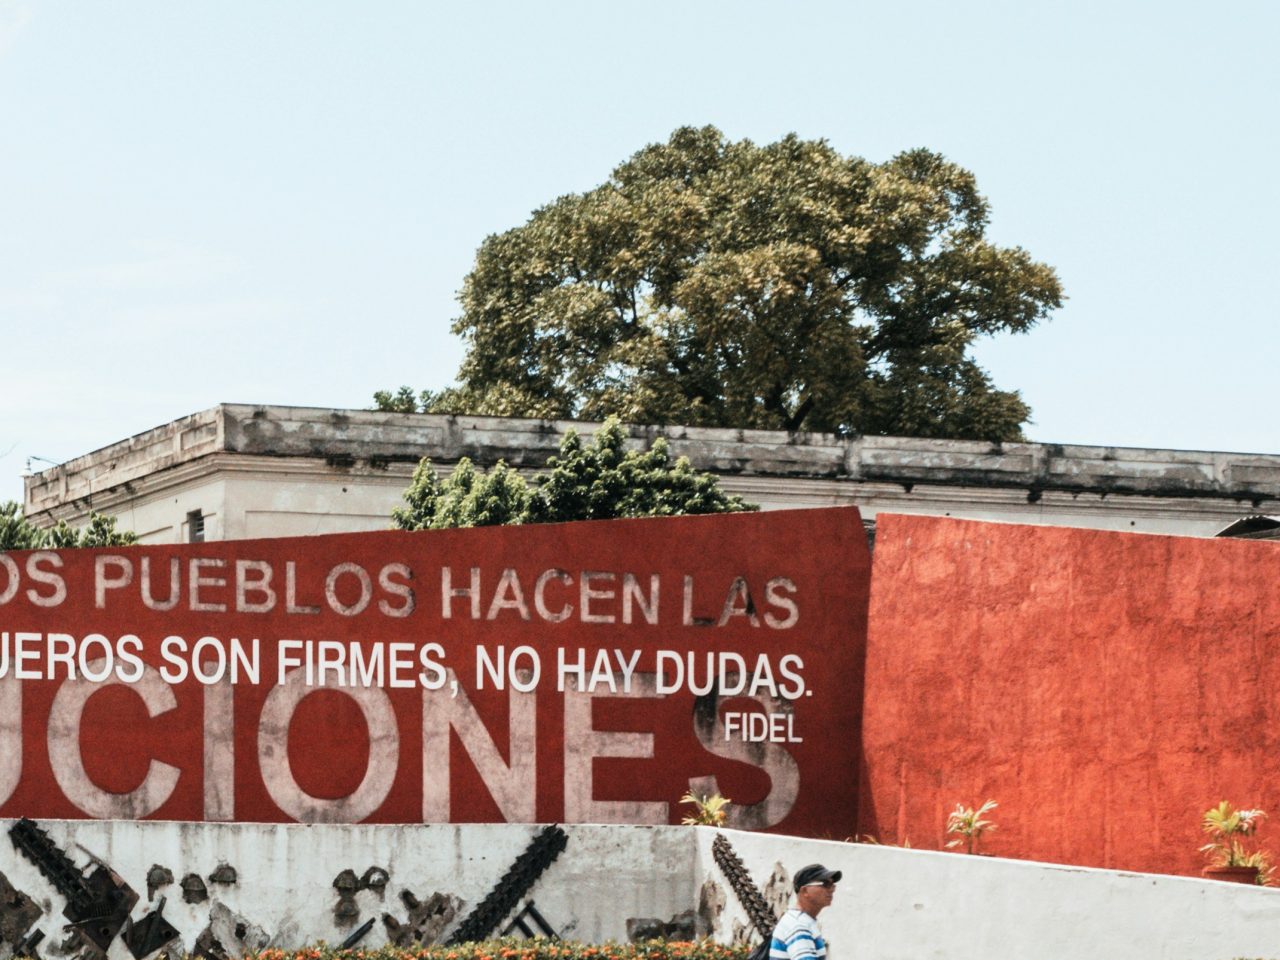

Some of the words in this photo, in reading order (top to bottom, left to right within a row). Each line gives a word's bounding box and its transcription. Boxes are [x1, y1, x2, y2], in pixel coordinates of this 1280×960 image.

[94, 555, 416, 618] PUEBLOS
[440, 565, 660, 624] HACEN
[682, 574, 800, 629] LAS
[158, 634, 261, 685] SON
[276, 638, 460, 698] FIRMES,
[475, 644, 541, 693] NO
[556, 647, 642, 693] HAY
[654, 649, 814, 700] DUDAS.
[723, 711, 804, 744] FIDEL
